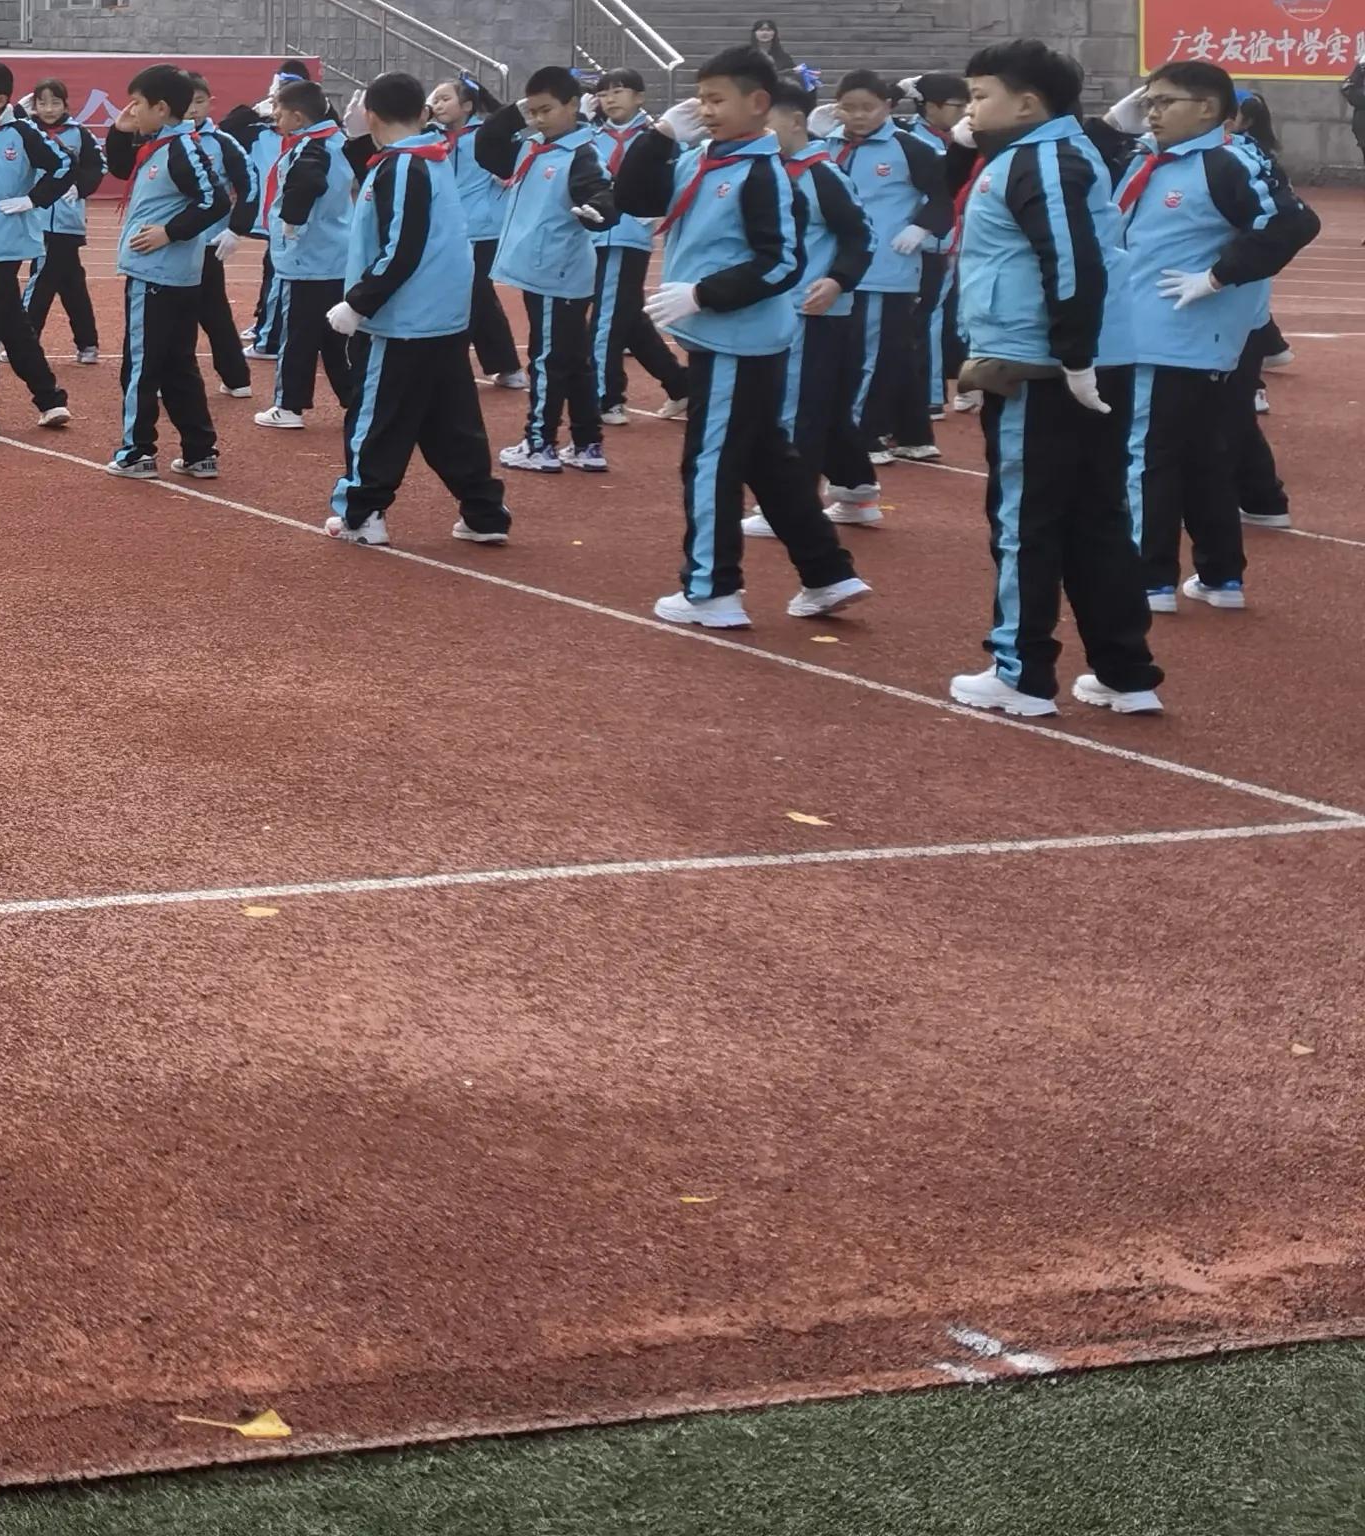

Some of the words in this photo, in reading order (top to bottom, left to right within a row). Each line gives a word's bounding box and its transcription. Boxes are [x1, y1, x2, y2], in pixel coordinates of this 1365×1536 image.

[1166, 26, 1365, 67] 广安友谊中学实
